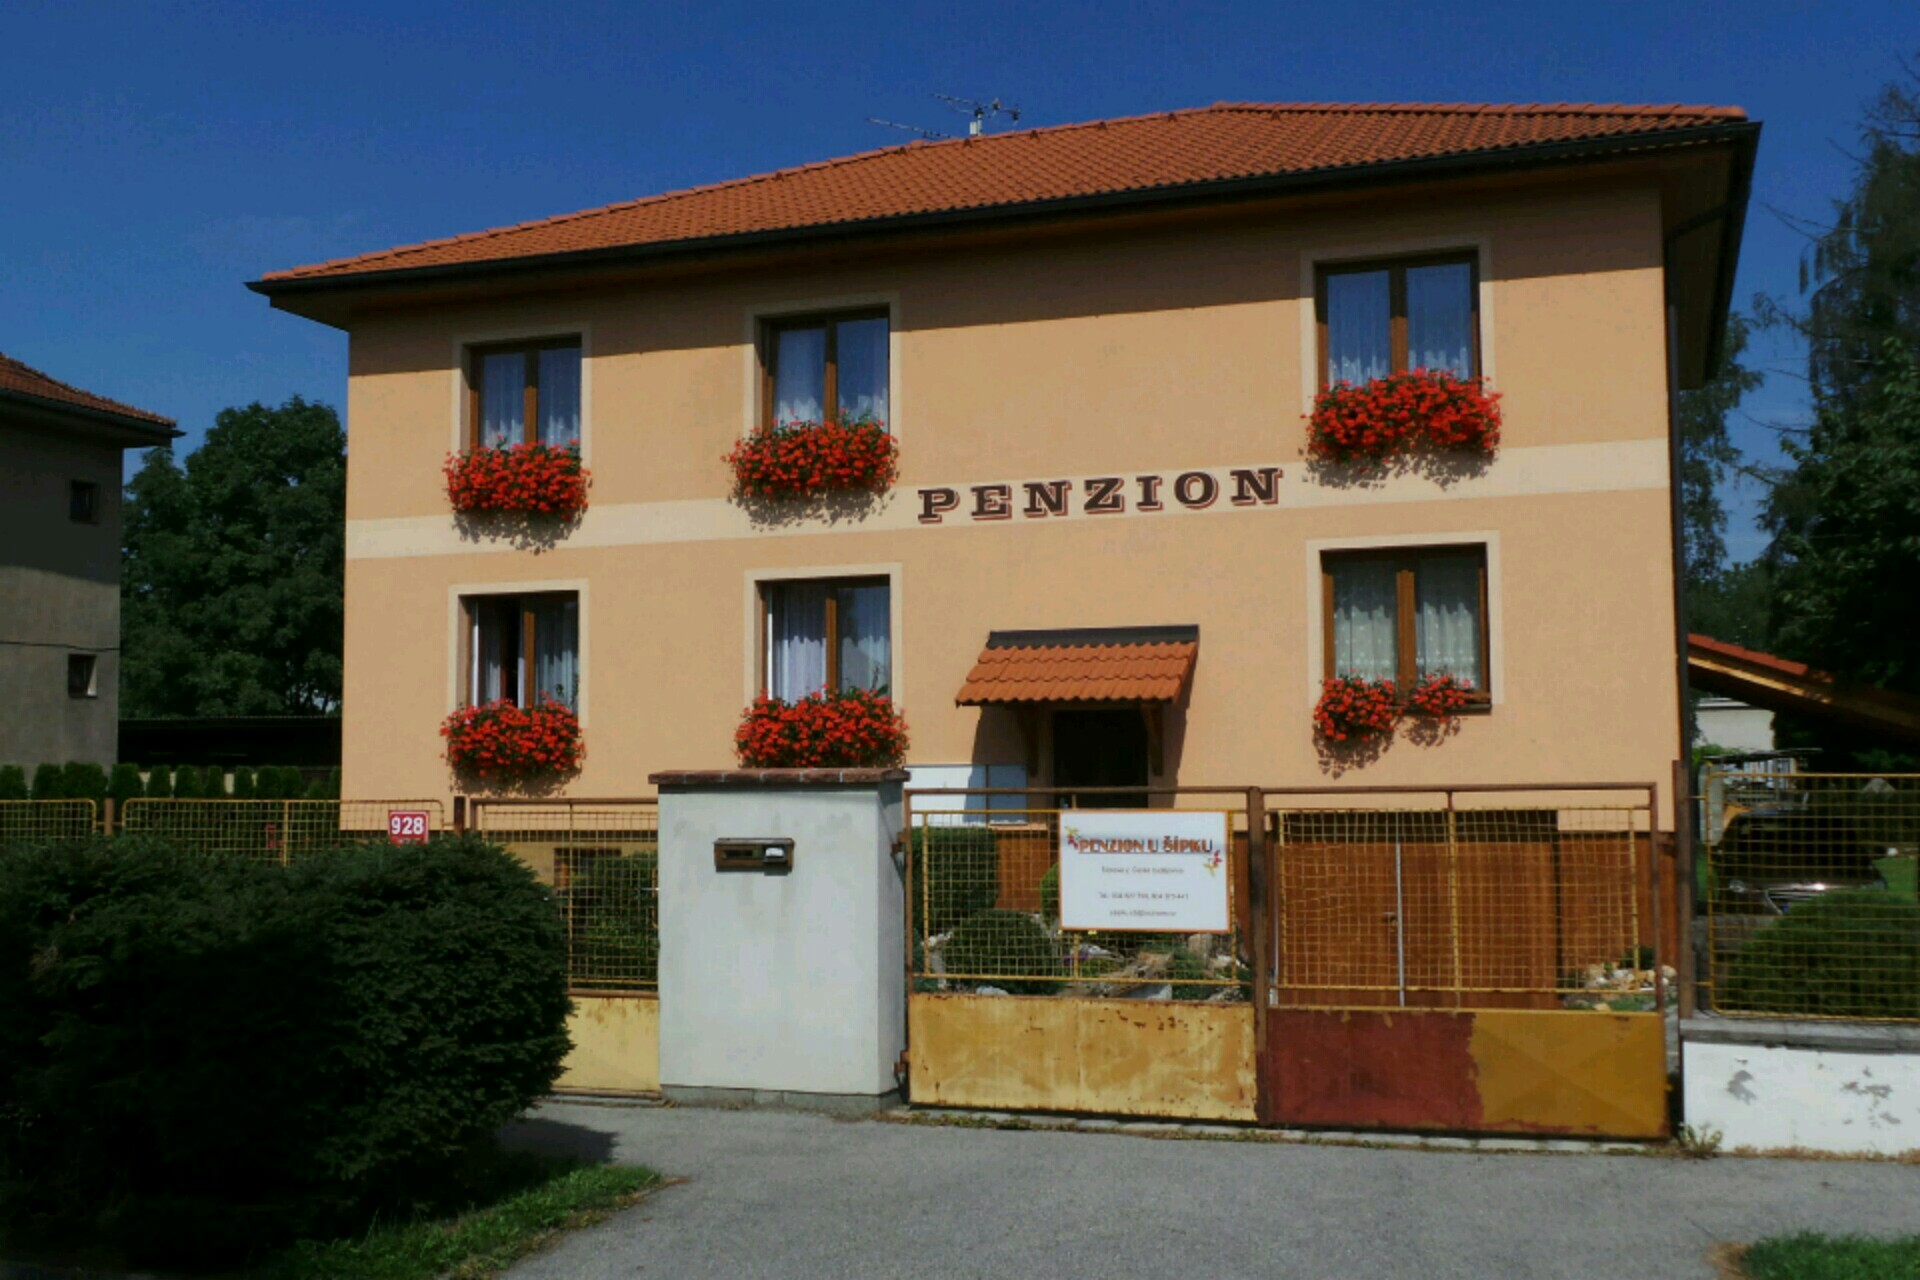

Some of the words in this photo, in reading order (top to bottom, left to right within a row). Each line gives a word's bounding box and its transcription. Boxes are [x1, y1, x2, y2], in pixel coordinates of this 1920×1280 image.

[917, 467, 1283, 524] PENZION
[391, 816, 424, 835] 928
[1078, 838, 1145, 853] PENZION
[1147, 838, 1159, 853] U
